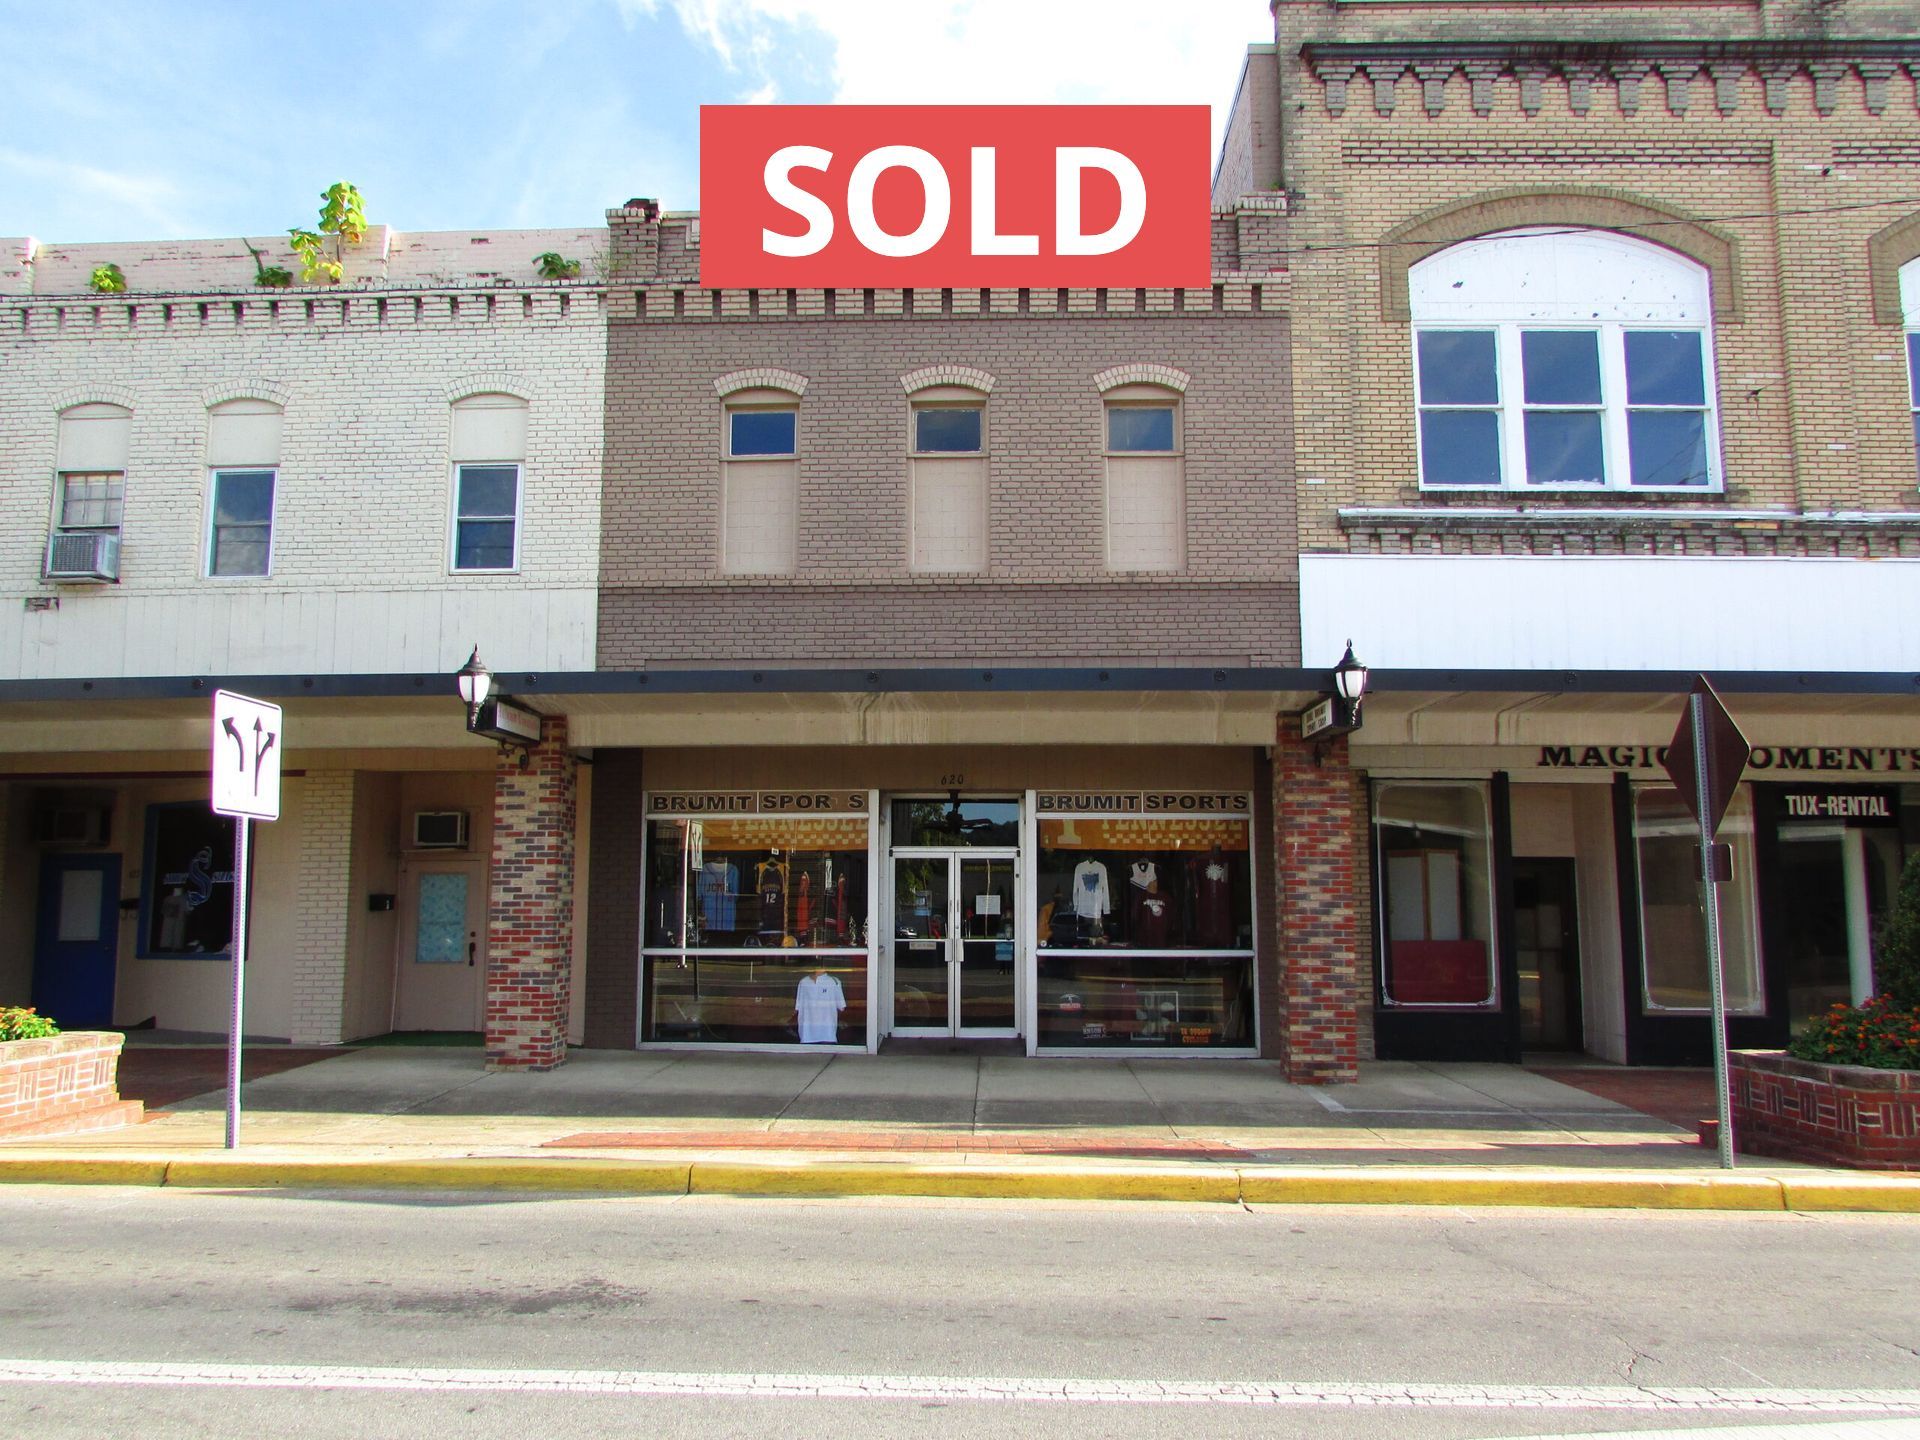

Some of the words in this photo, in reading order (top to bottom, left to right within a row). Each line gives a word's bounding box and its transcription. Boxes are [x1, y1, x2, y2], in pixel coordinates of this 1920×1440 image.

[1747, 747, 1920, 770] OMENTS
[941, 774, 964, 785] 620
[653, 796, 752, 810] BRUMIT
[1038, 795, 1139, 809] BRUMIT
[1146, 795, 1248, 809] SPORTS
[1784, 794, 1891, 818] TUX-RENTAL
[765, 893, 777, 904] 12
